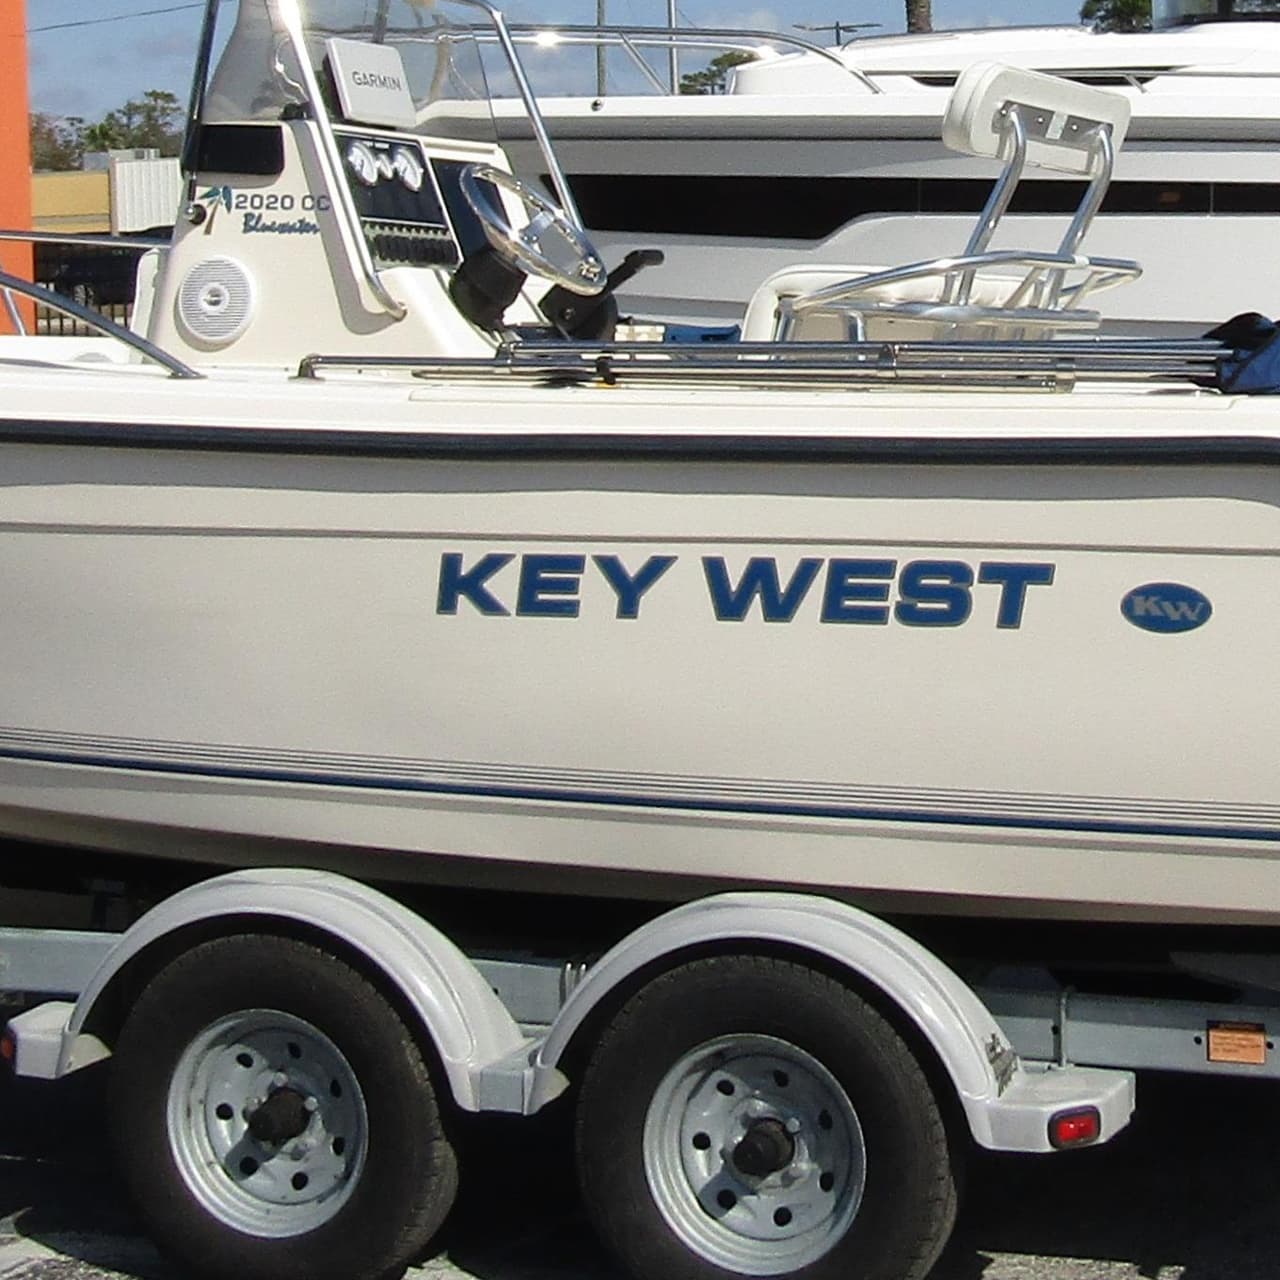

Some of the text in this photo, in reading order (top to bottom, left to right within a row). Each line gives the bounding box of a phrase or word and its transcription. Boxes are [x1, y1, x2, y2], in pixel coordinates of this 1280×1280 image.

[352, 71, 402, 91] GARMIN
[235, 194, 295, 210] 2020
[435, 552, 1056, 630] KEY WEST
